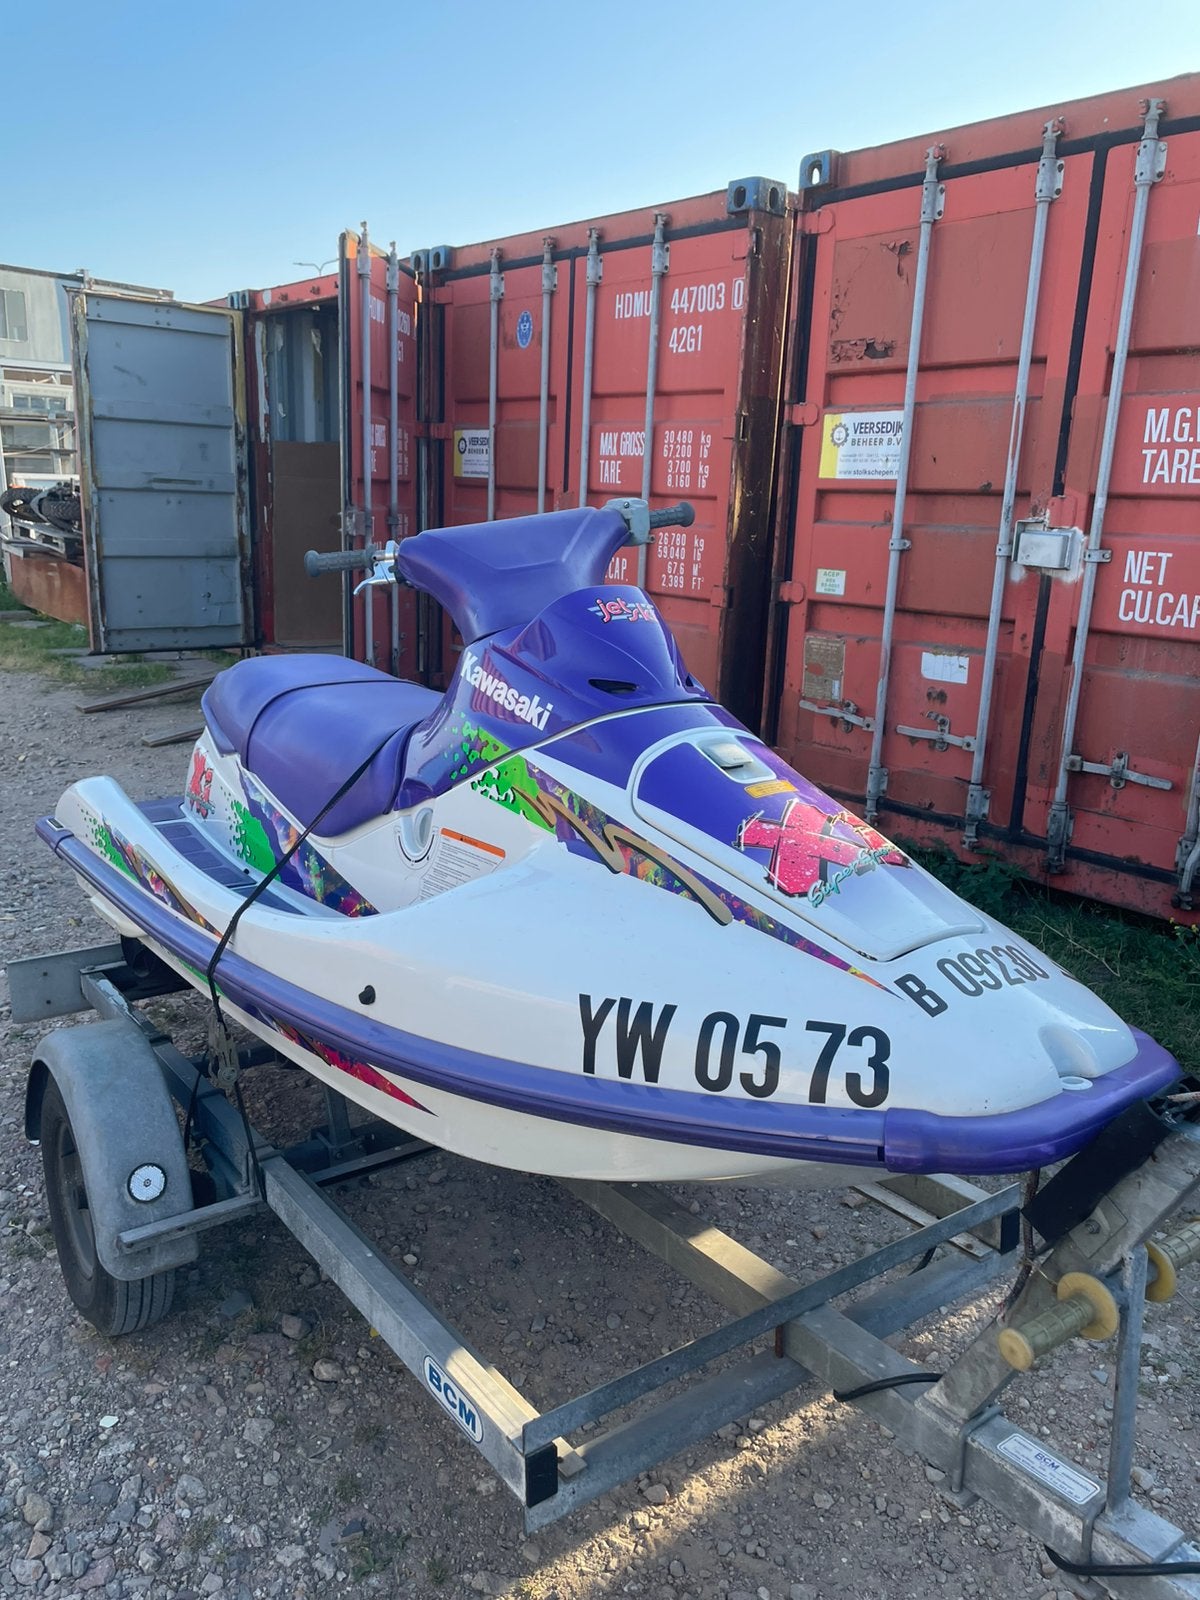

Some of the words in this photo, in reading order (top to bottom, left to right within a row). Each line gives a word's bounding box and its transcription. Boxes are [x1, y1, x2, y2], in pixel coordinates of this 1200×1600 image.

[615, 290, 653, 319] HDMU
[671, 282, 725, 314] 447003
[669, 325, 703, 353] 42G1
[853, 421, 904, 437] VEERSEDIJK
[1144, 408, 1200, 443] M.G.
[600, 432, 619, 456] MAX
[620, 431, 646, 456] GROSS
[664, 430, 693, 445] 30.480
[701, 431, 712, 448] kg
[663, 444, 692, 459] 67.200
[699, 445, 709, 458] lb
[851, 437, 884, 447] BEHEER
[599, 460, 622, 484] TARE
[667, 460, 691, 474] 3.700
[699, 461, 710, 478] kg
[1142, 449, 1200, 484] TARE
[667, 474, 690, 488] 8.160
[698, 475, 707, 488] lb
[657, 546, 686, 560] 59.040
[658, 532, 686, 547] 26.780
[694, 535, 704, 551] kg
[661, 574, 684, 588] 2.389
[667, 561, 685, 575] 67.6
[1123, 550, 1173, 586] NET
[595, 597, 632, 623] jet
[460, 651, 554, 731] Kawasaki
[894, 973, 949, 1018] B
[936, 944, 1050, 997] 09230
[578, 993, 678, 1084] YW
[694, 1011, 788, 1098] 05
[805, 1020, 891, 1108] 73
[428, 1362, 477, 1434] BCM
[1034, 1452, 1060, 1471] BCM
